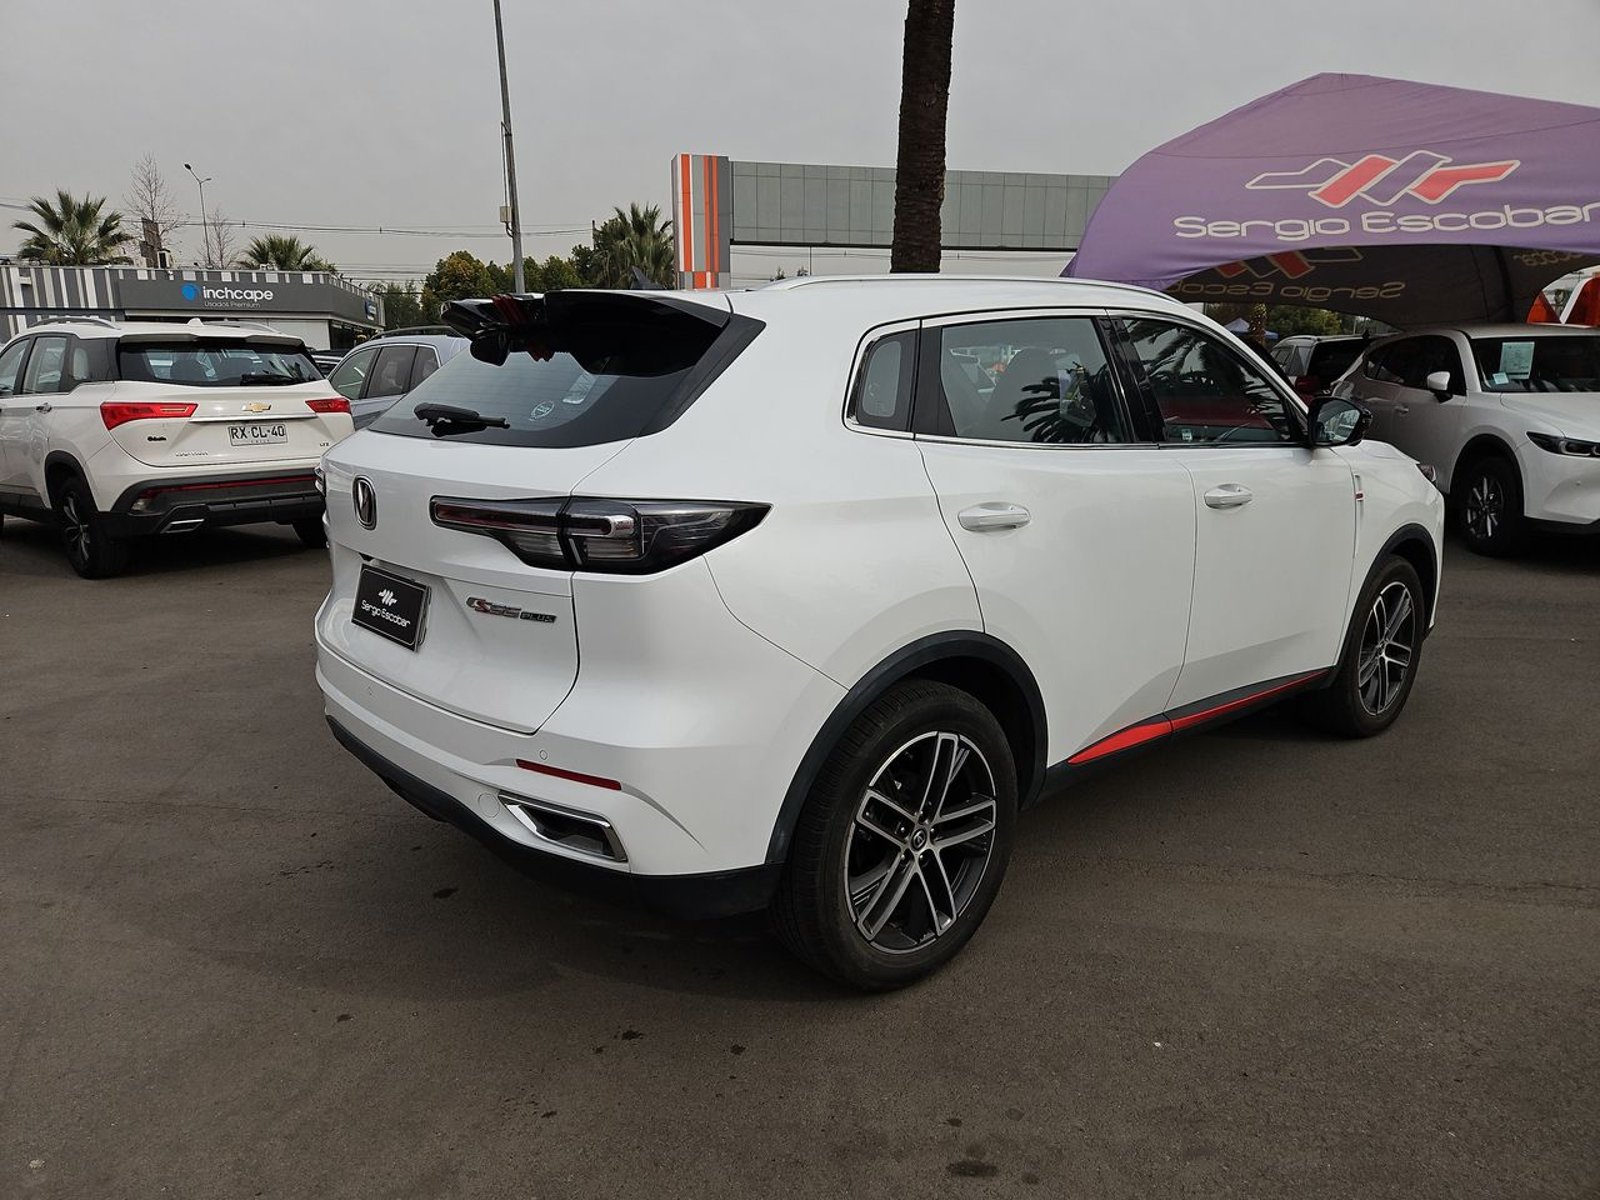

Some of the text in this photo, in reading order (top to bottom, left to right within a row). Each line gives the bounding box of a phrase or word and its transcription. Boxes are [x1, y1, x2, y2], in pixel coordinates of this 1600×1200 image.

[1174, 201, 1600, 242] Sergio Escobar
[202, 285, 274, 303] inchcape
[361, 599, 411, 628] Sergio Escobar
[519, 611, 557, 624] PLUS
